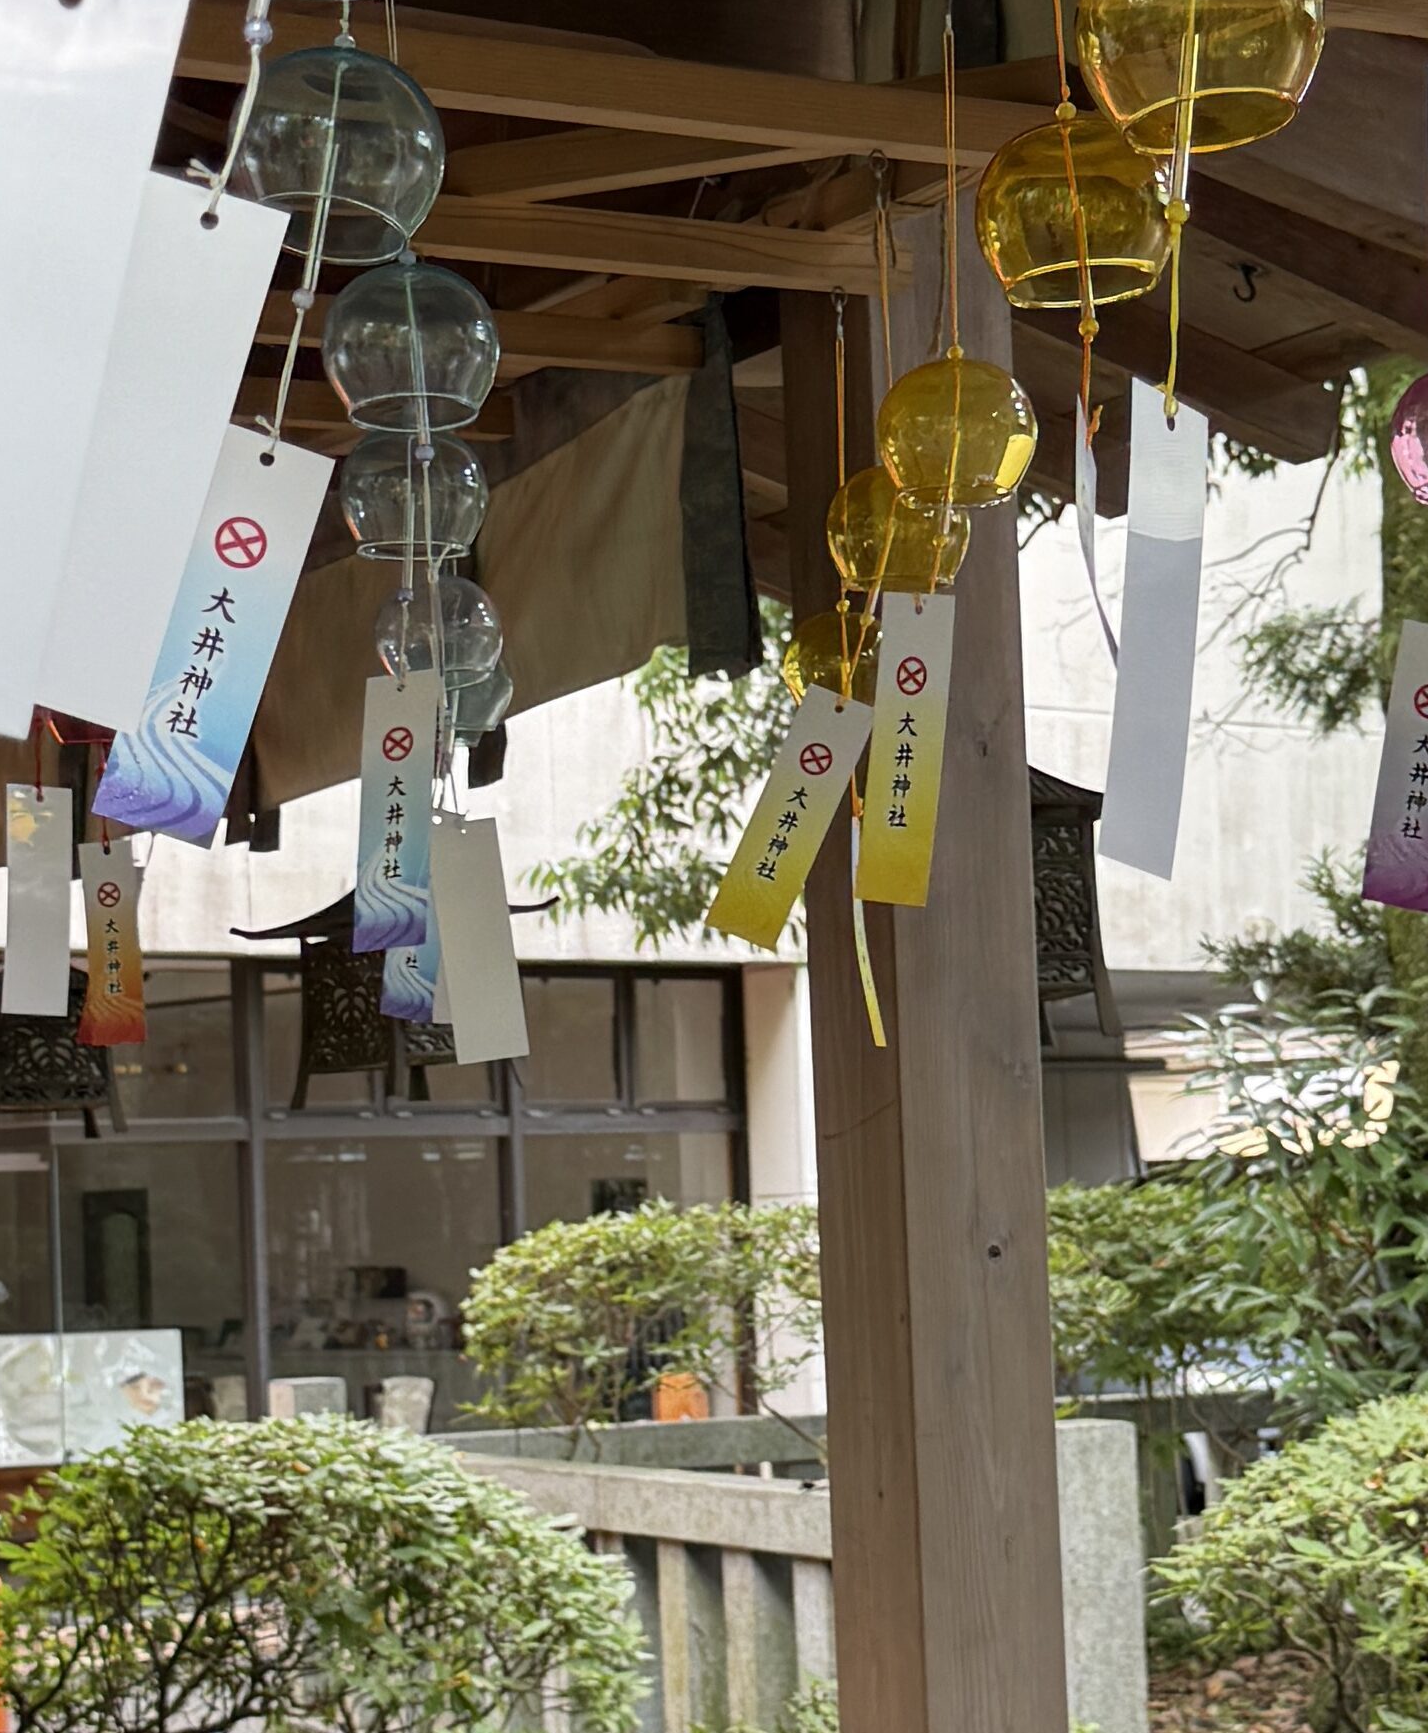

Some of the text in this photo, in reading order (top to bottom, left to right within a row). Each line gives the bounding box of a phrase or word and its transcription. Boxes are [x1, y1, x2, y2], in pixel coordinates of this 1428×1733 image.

[168, 587, 235, 740] 大井神社
[886, 711, 918, 829] 大井神社
[383, 774, 406, 881] 大井神社
[756, 786, 808, 881] 大井神社
[104, 918, 123, 995] 大井神社
